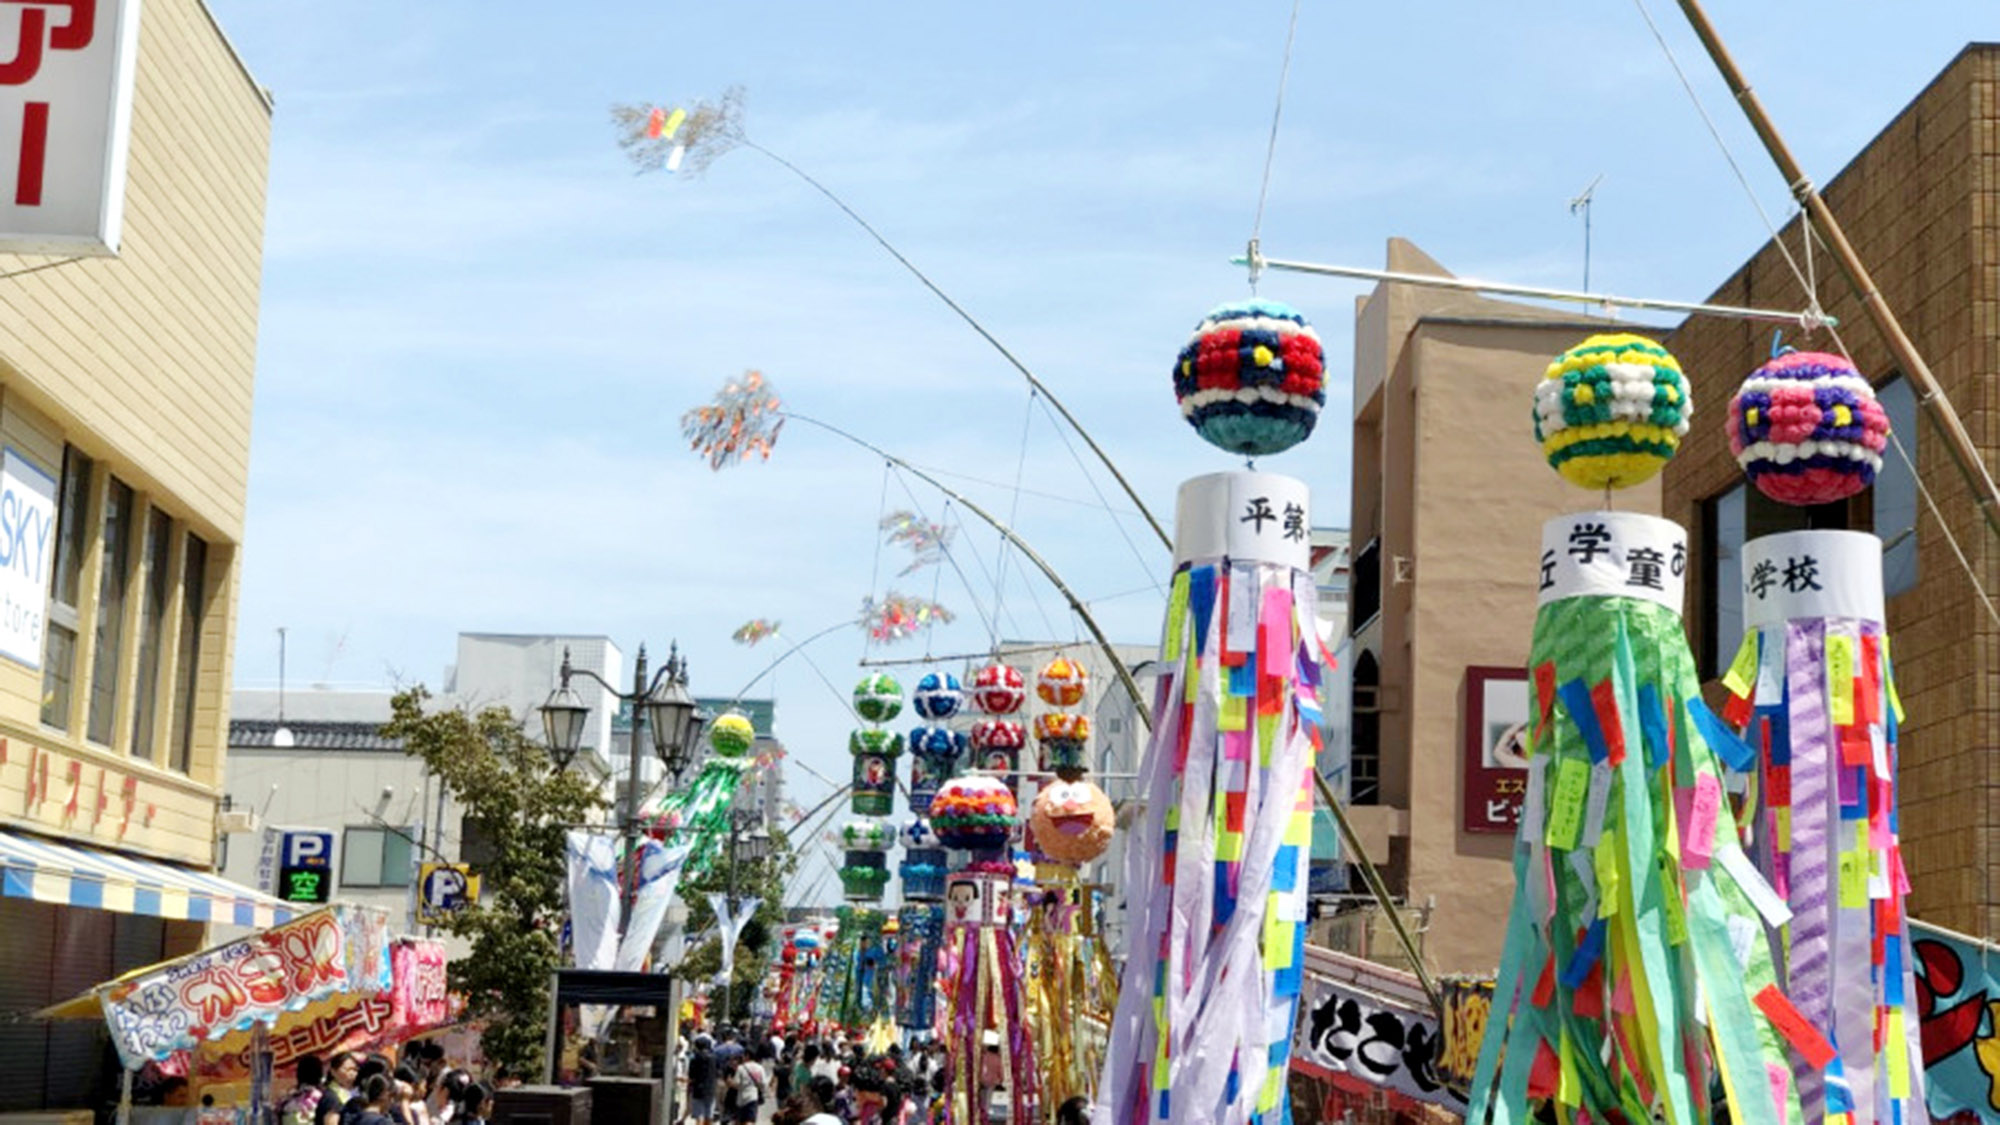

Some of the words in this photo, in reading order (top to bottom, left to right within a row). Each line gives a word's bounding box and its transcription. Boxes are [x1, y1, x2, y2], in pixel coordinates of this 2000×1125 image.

[0, 488, 52, 584] SKY
[290, 834, 324, 866] P
[288, 871, 319, 900] 空
[432, 869, 464, 907] P
[180, 914, 346, 1022] かき氷
